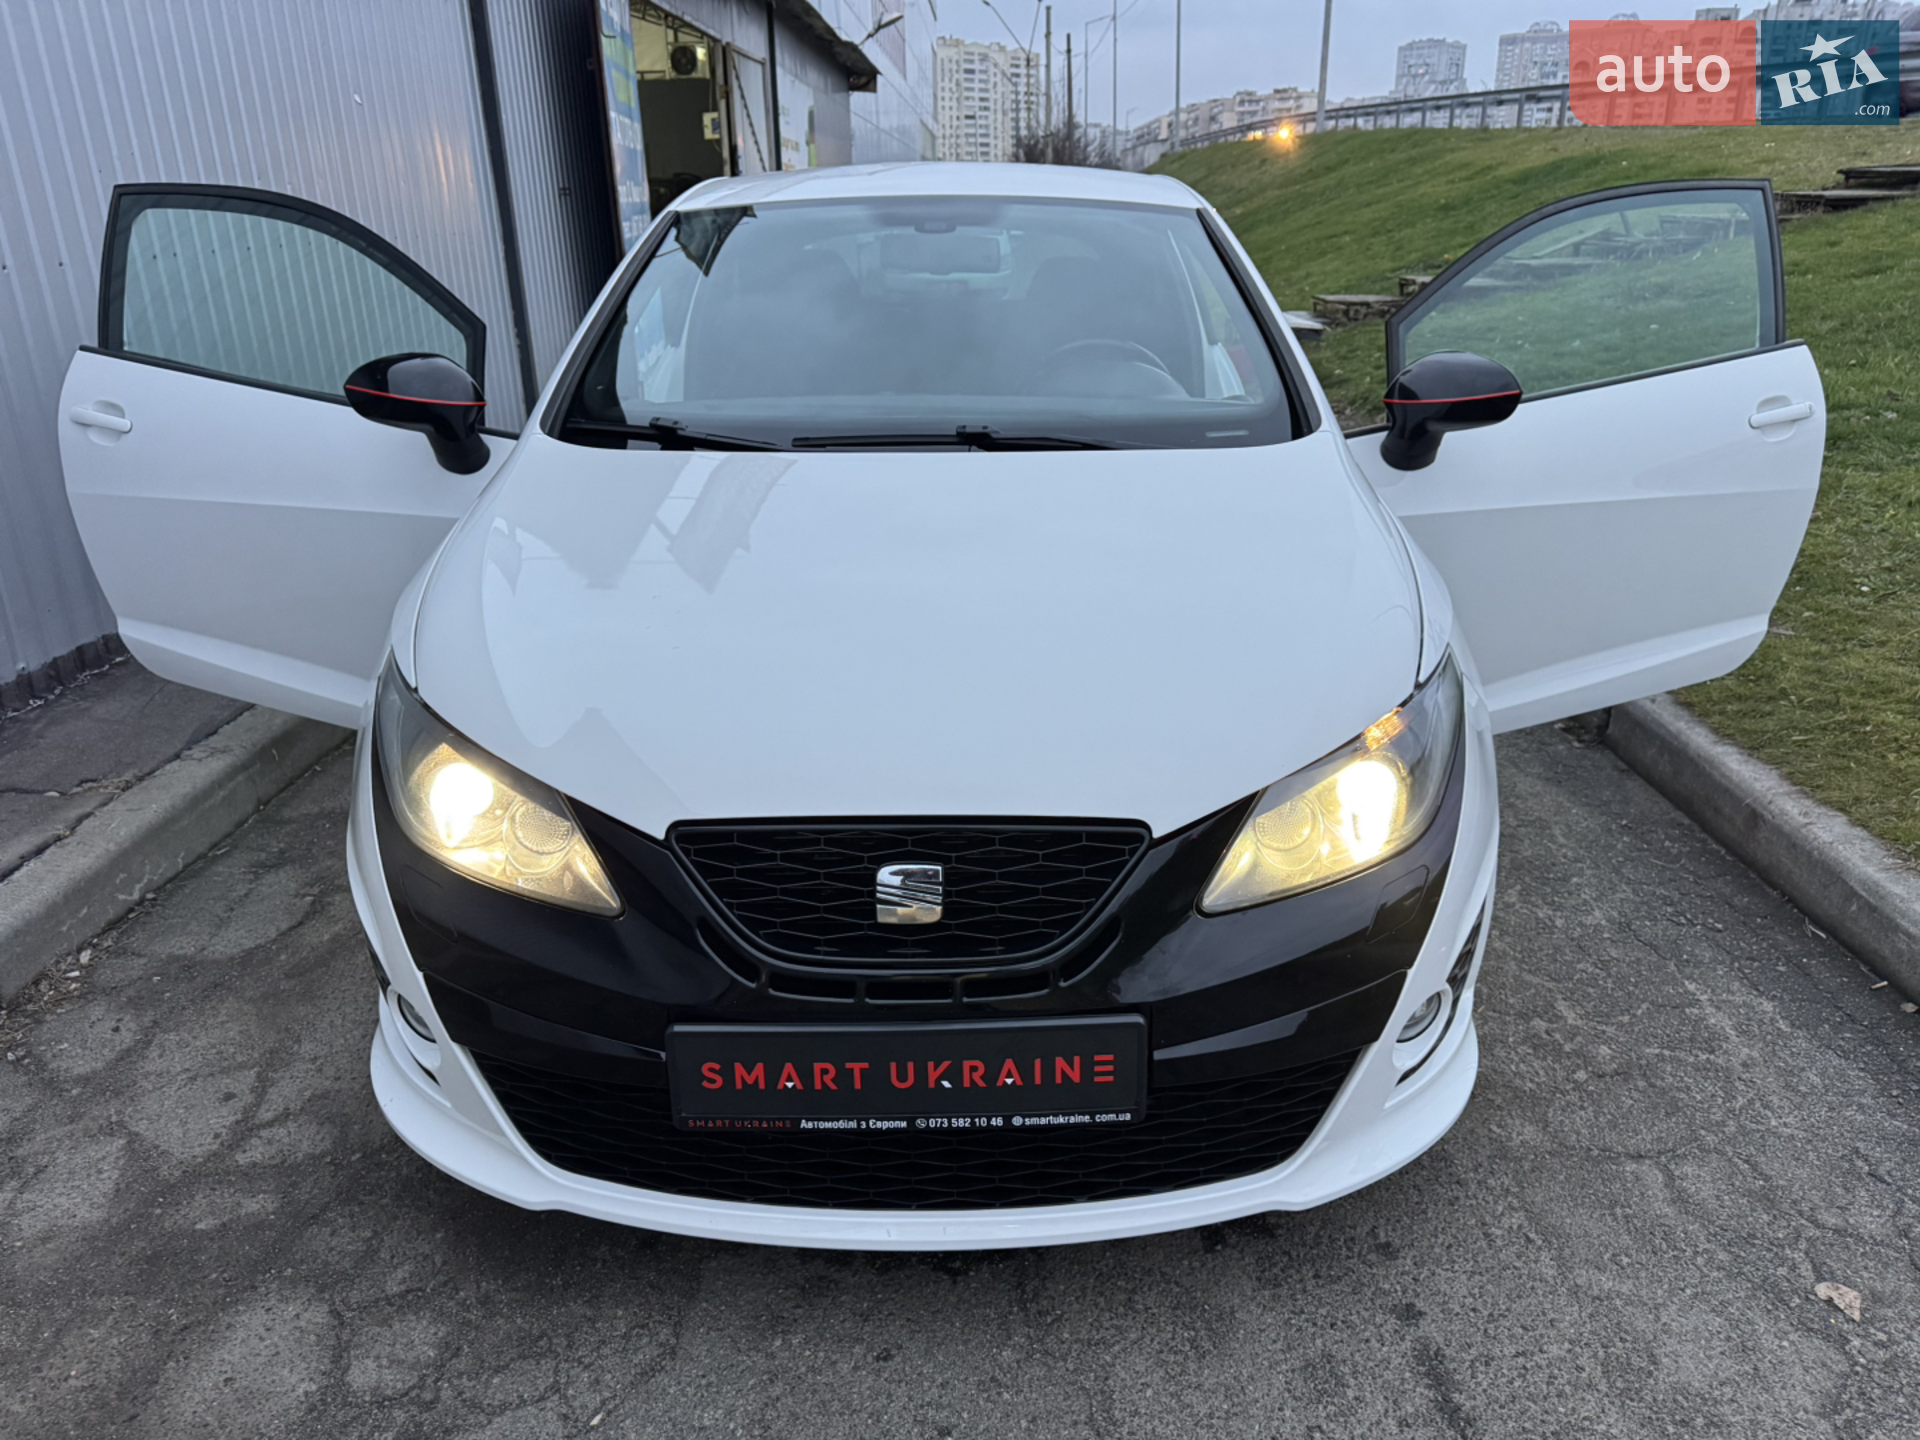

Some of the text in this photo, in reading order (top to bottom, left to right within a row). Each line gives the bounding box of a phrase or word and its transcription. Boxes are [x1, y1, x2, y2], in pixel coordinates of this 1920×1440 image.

[700, 1054, 1115, 1091] SMART UKRAINE
[688, 1119, 792, 1129] SMART UKRAINE
[800, 1119, 908, 1130] Автомобілі з Європи
[928, 1117, 1004, 1128] 073 582 10 46
